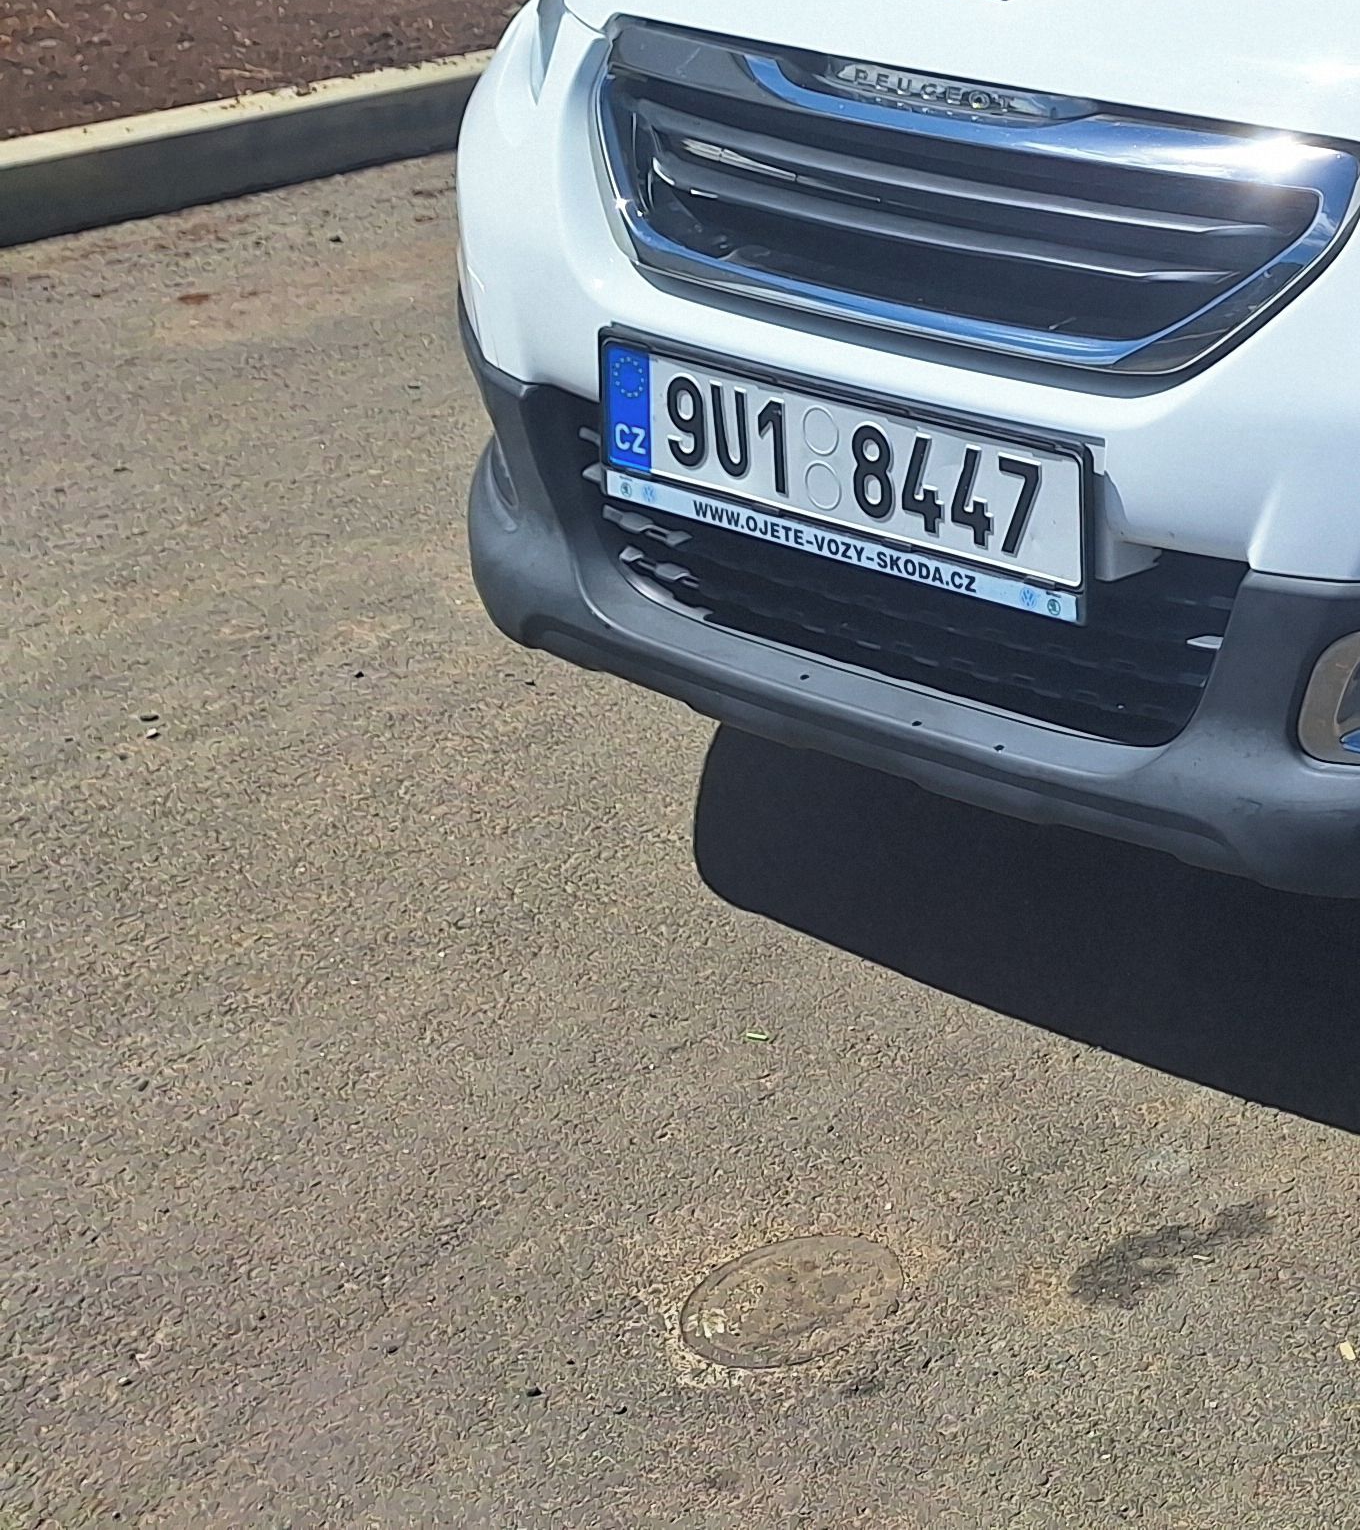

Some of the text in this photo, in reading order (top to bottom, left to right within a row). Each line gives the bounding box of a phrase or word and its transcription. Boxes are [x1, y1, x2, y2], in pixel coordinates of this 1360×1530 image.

[854, 68, 1014, 112] PEUGEOT
[615, 422, 647, 455] CZ
[666, 374, 1041, 555] 9U1 8447
[692, 499, 977, 594] WWW.OJETE-VOZY-SKODA.CZ
